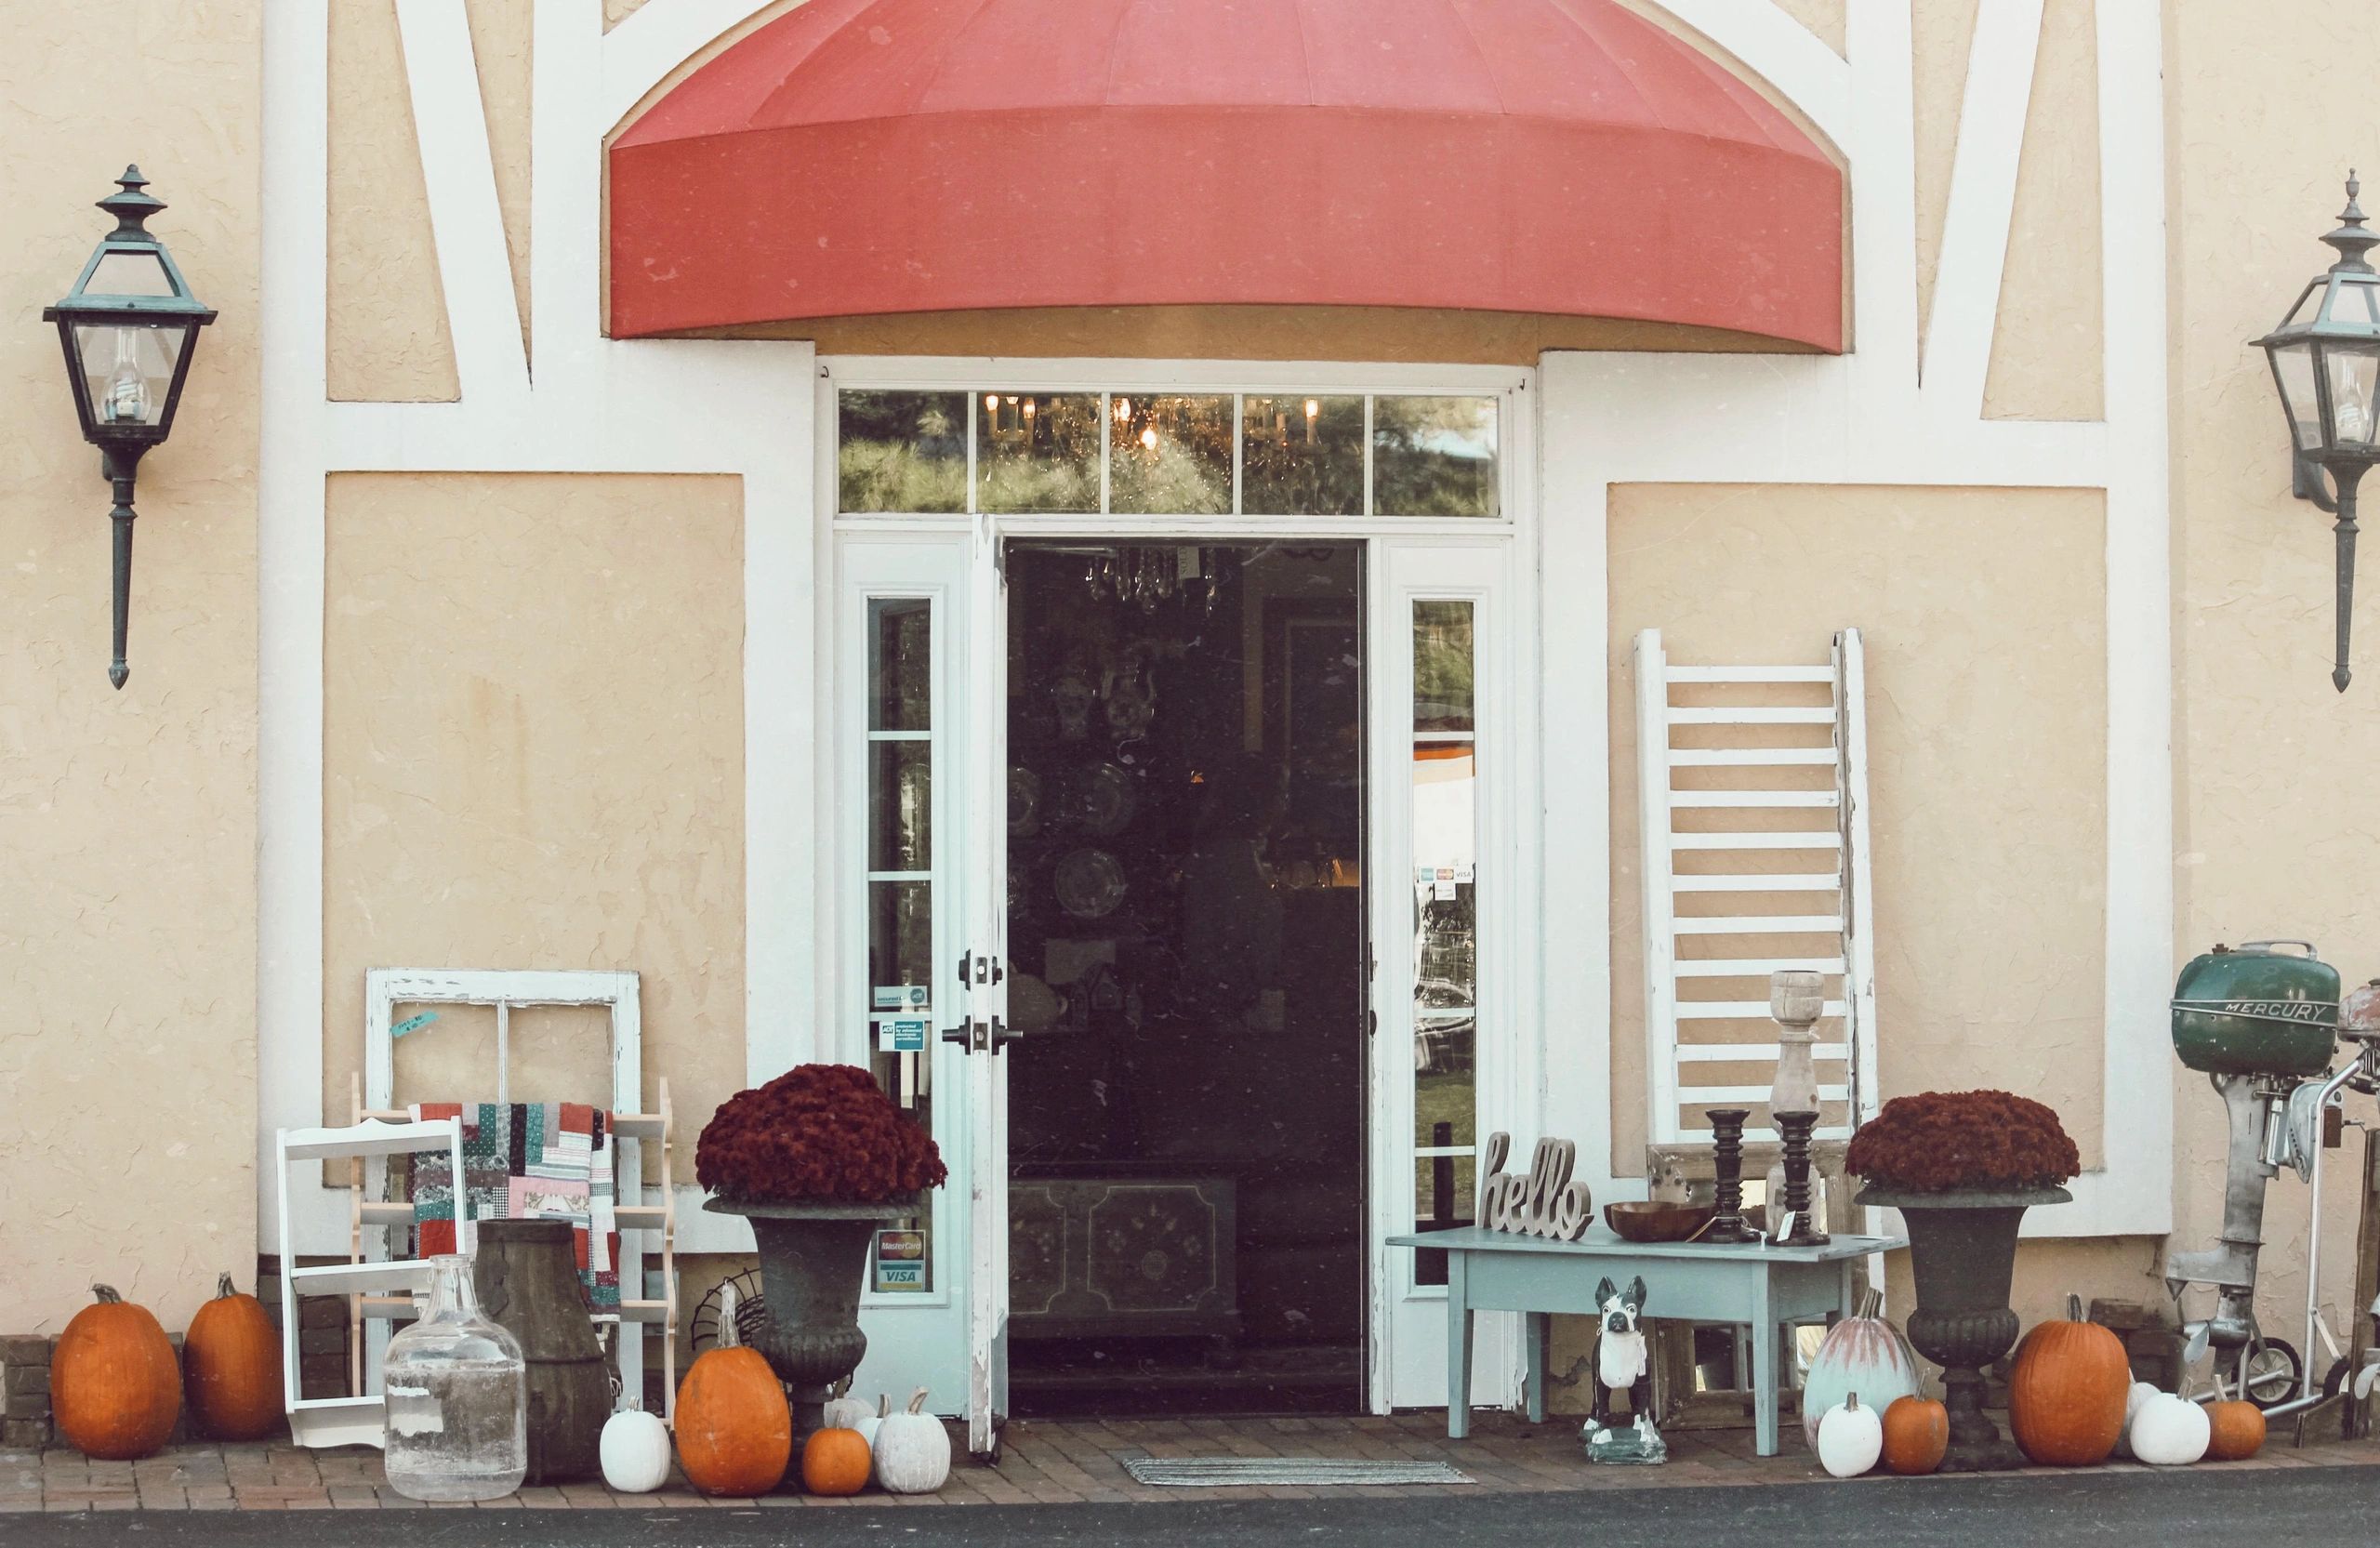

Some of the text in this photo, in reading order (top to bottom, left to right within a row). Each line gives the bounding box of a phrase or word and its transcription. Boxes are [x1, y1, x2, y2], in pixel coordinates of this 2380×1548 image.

[2225, 1002, 2328, 1022] MERCURY
[1476, 1131, 1595, 1241] hello
[881, 1241, 921, 1250] MasterCard
[886, 1271, 916, 1282] VISA
